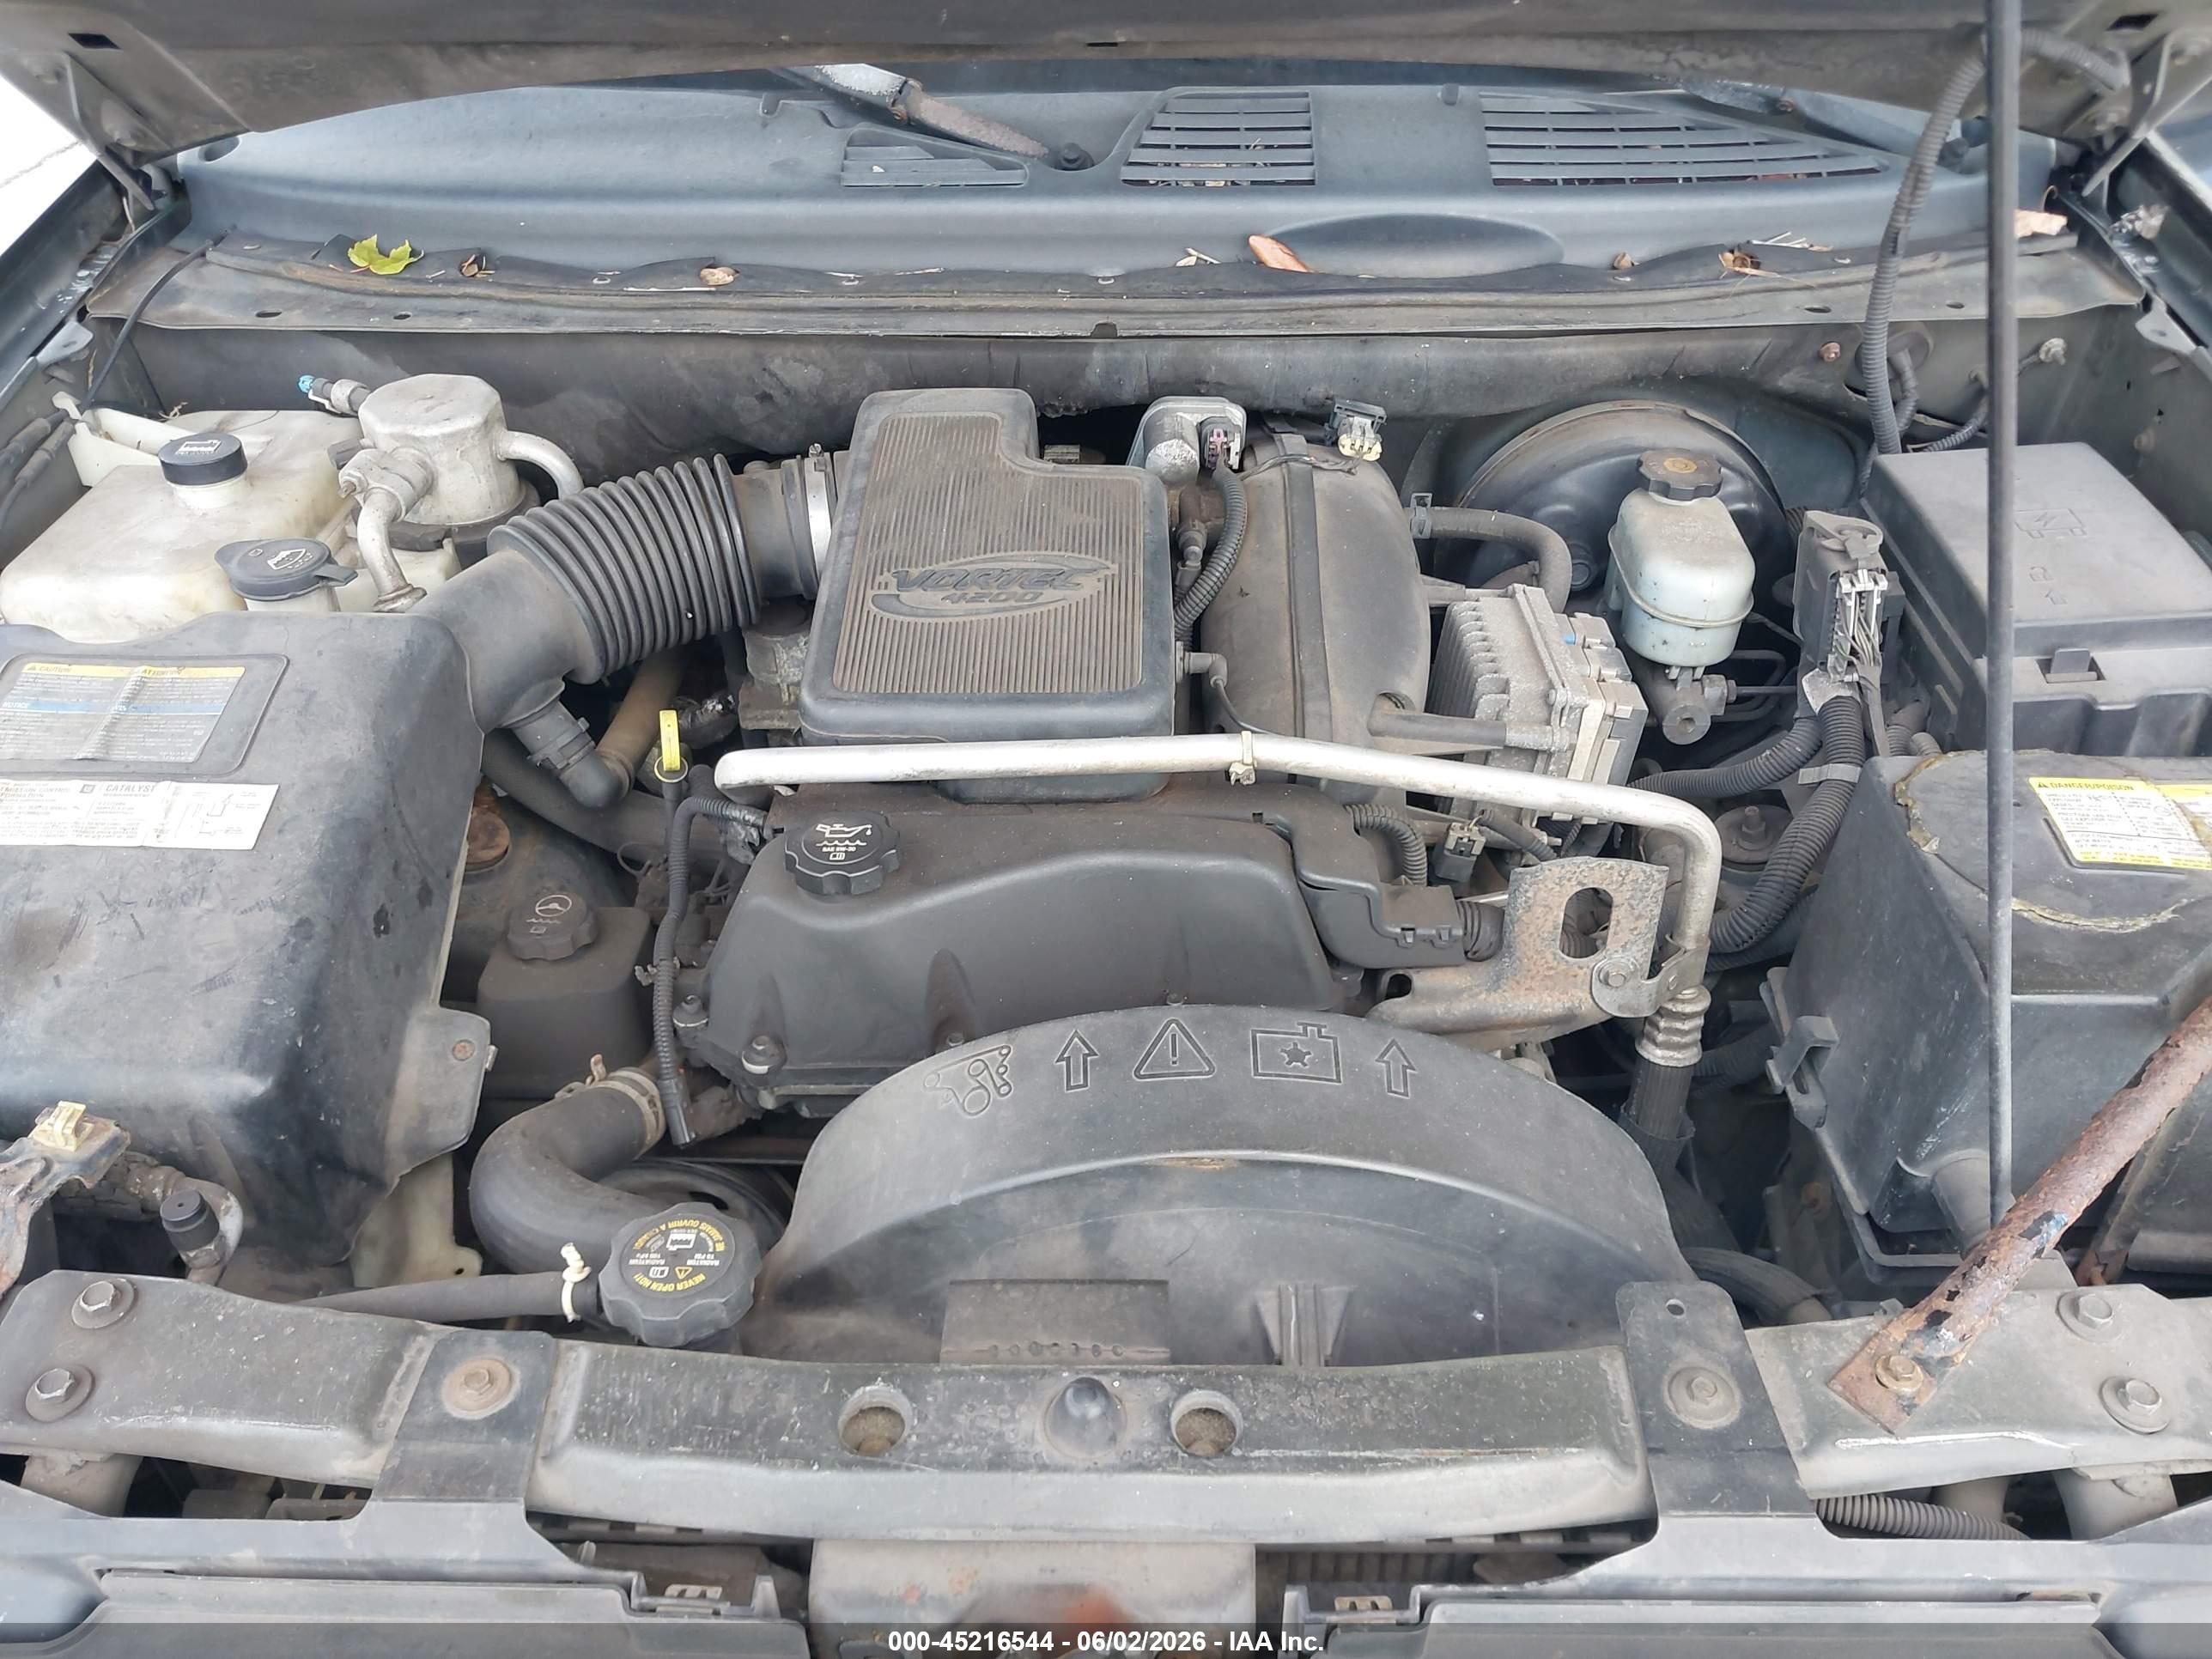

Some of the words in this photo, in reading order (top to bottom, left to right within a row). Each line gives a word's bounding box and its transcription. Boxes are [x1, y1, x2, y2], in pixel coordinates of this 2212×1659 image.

[892, 567, 1087, 592] VORTEC
[941, 591, 1044, 605] 4200
[105, 784, 157, 793] CATALYST
[667, 1219, 700, 1229] OUVRIR
[651, 1282, 675, 1292] OPEN
[676, 1273, 706, 1291] NEVER
